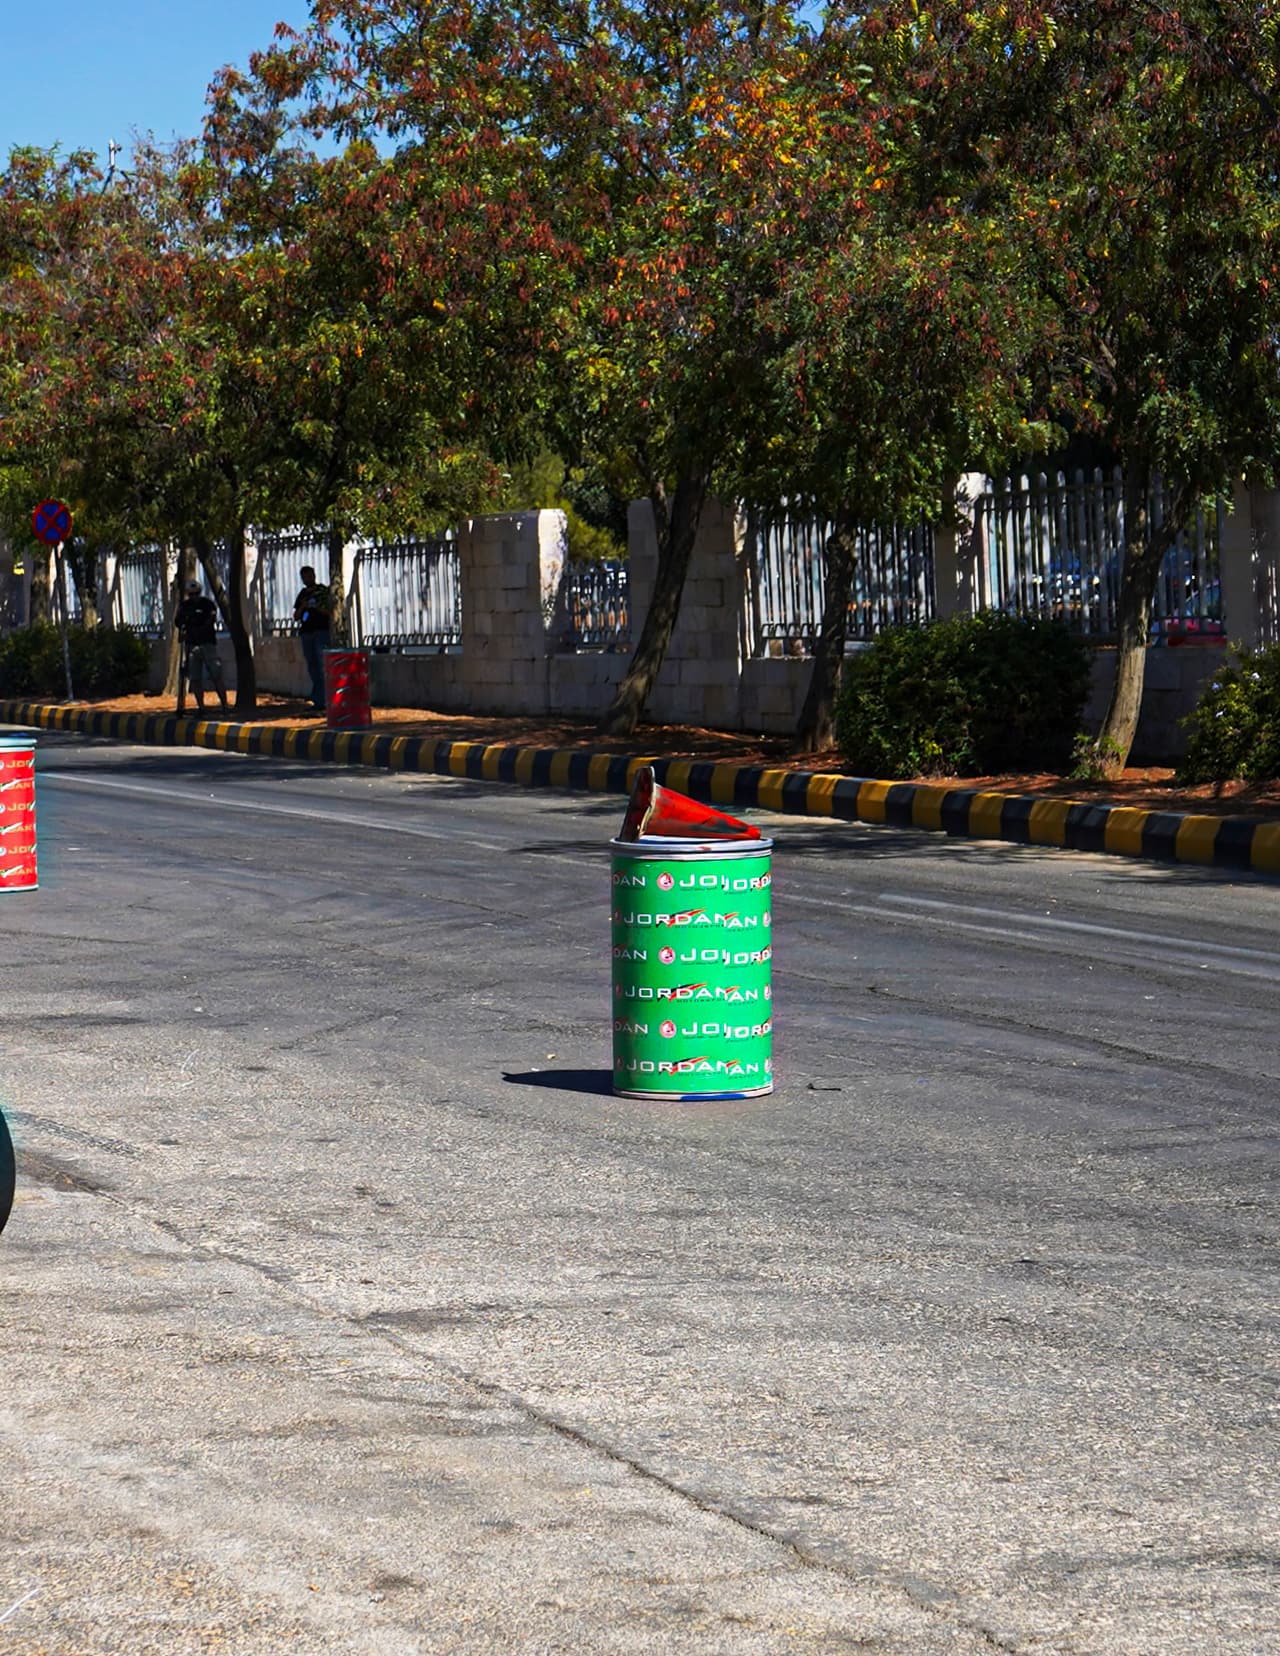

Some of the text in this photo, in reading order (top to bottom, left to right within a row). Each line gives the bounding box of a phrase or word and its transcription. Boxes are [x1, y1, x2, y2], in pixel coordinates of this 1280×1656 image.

[624, 913, 725, 926] JORDAN
[625, 985, 726, 998] JORDAN
[627, 1059, 727, 1072] JORDAN
